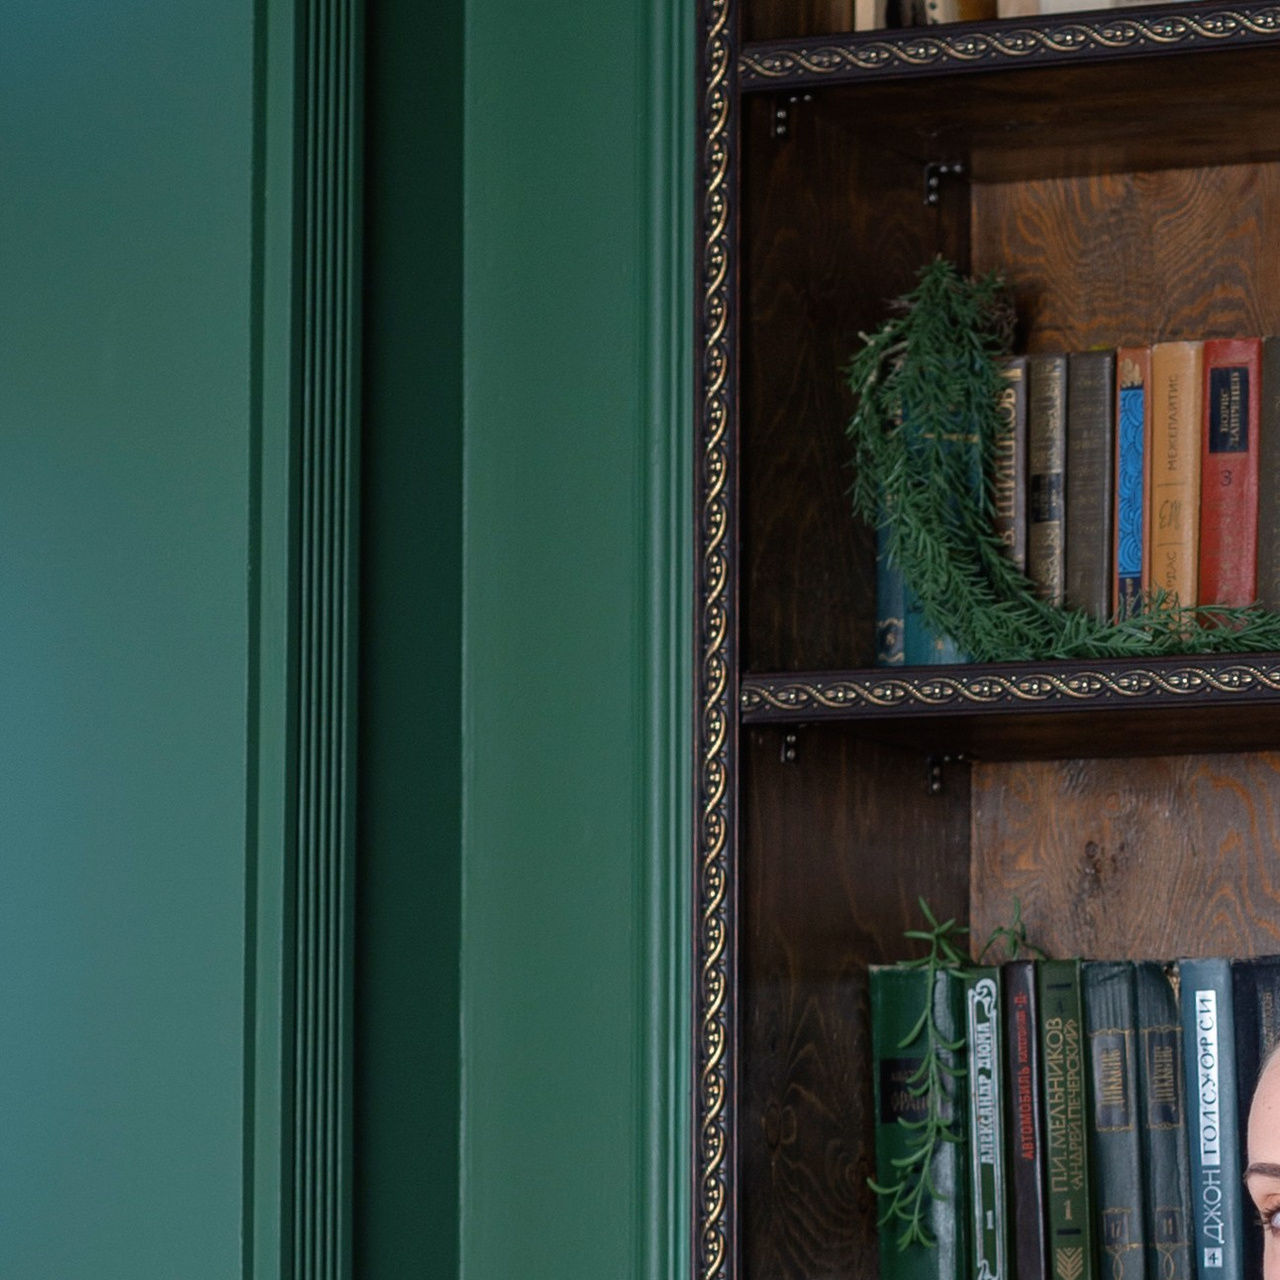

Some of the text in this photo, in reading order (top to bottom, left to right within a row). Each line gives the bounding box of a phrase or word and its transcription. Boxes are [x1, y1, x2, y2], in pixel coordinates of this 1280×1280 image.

[1219, 469, 1232, 487] 3
[976, 1023, 994, 1164] АЛЕКСАНДР ДЮМА
[1017, 1066, 1034, 1160] АВТОМОБИЛЬ
[1046, 1017, 1068, 1192] П.И. МЕЛЬНИКОВ
[1199, 998, 1225, 1245] ДЖОН ГОЛСУОРСИ
[986, 1210, 993, 1229] 1
